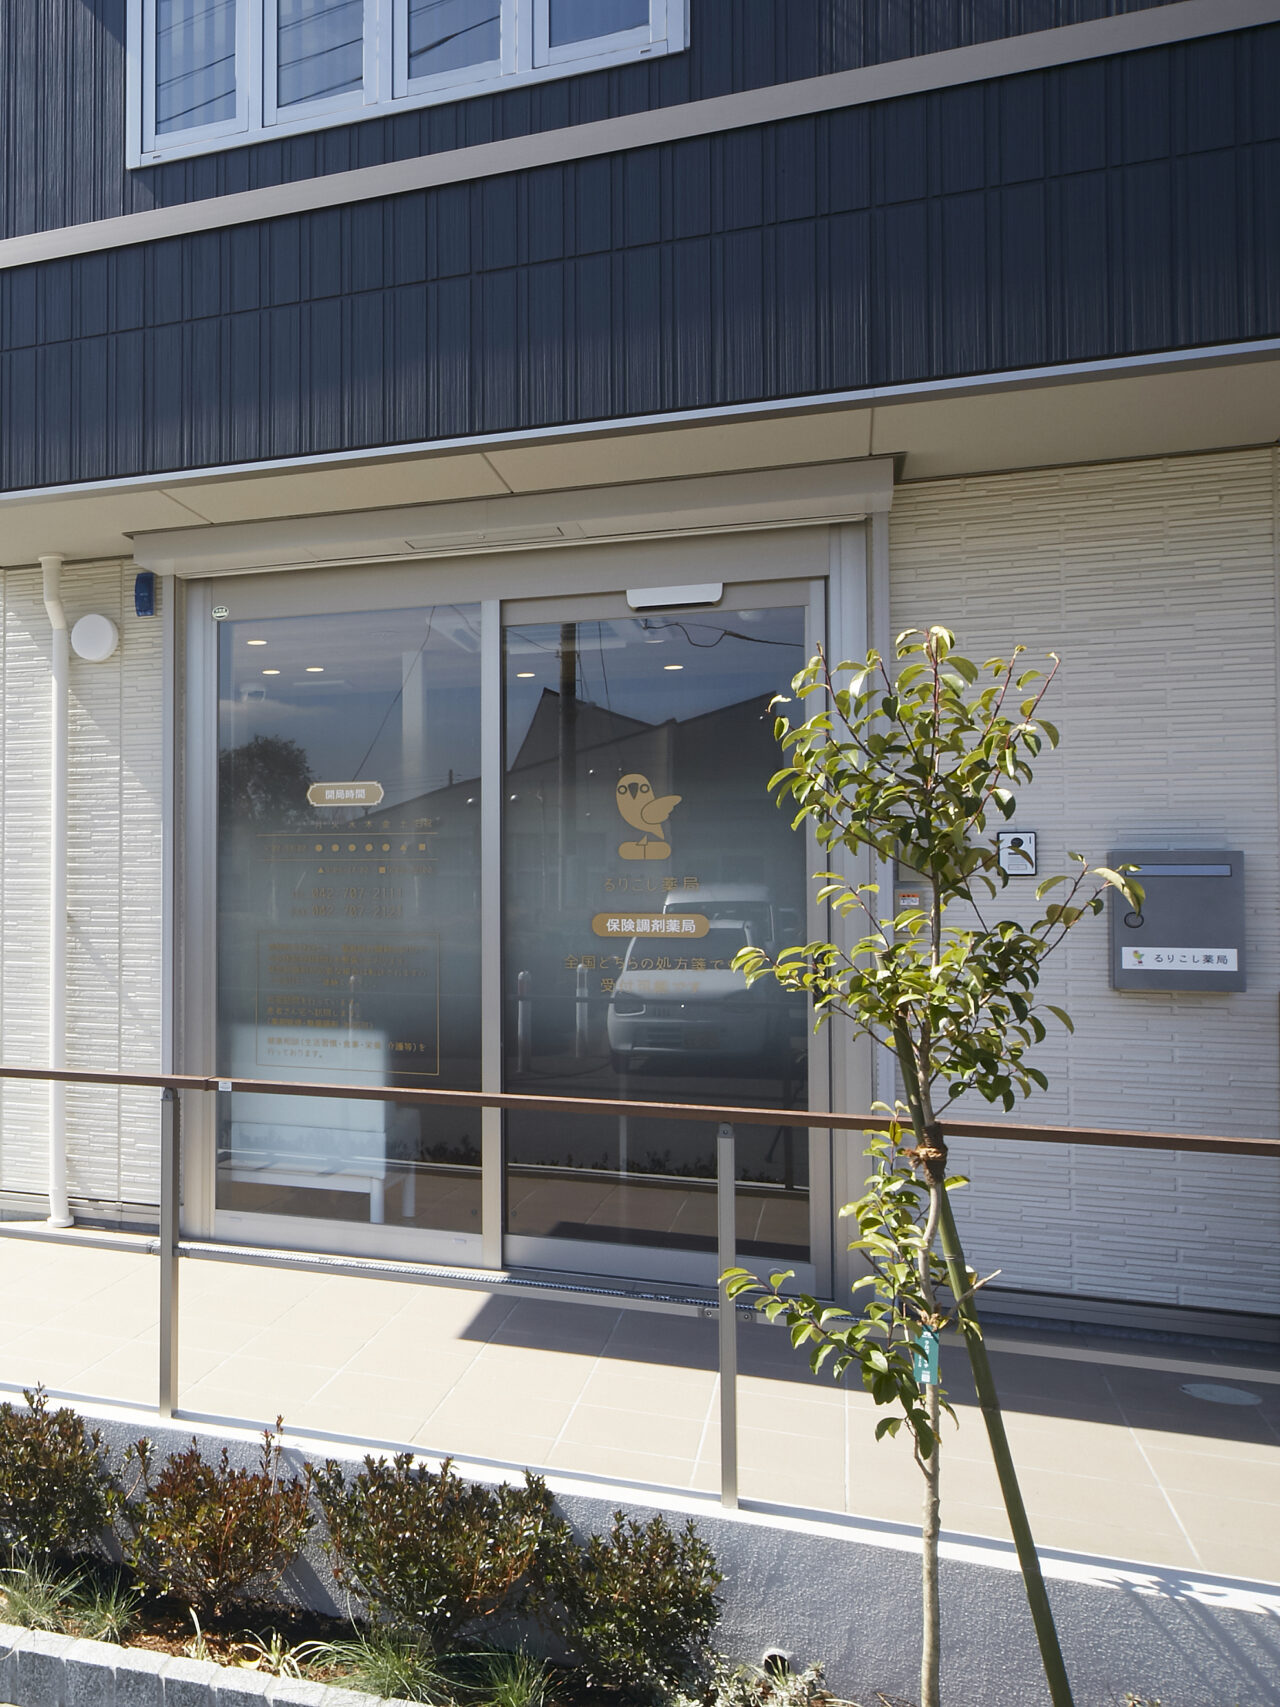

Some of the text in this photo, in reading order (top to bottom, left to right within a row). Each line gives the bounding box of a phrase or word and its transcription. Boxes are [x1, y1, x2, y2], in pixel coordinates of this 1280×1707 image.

[605, 876, 699, 892] るりこし薬局
[606, 918, 696, 933] 保険調剤薬局
[564, 954, 732, 971] 全国どちらの処方箋で
[1154, 954, 1228, 965] るりこし薬局
